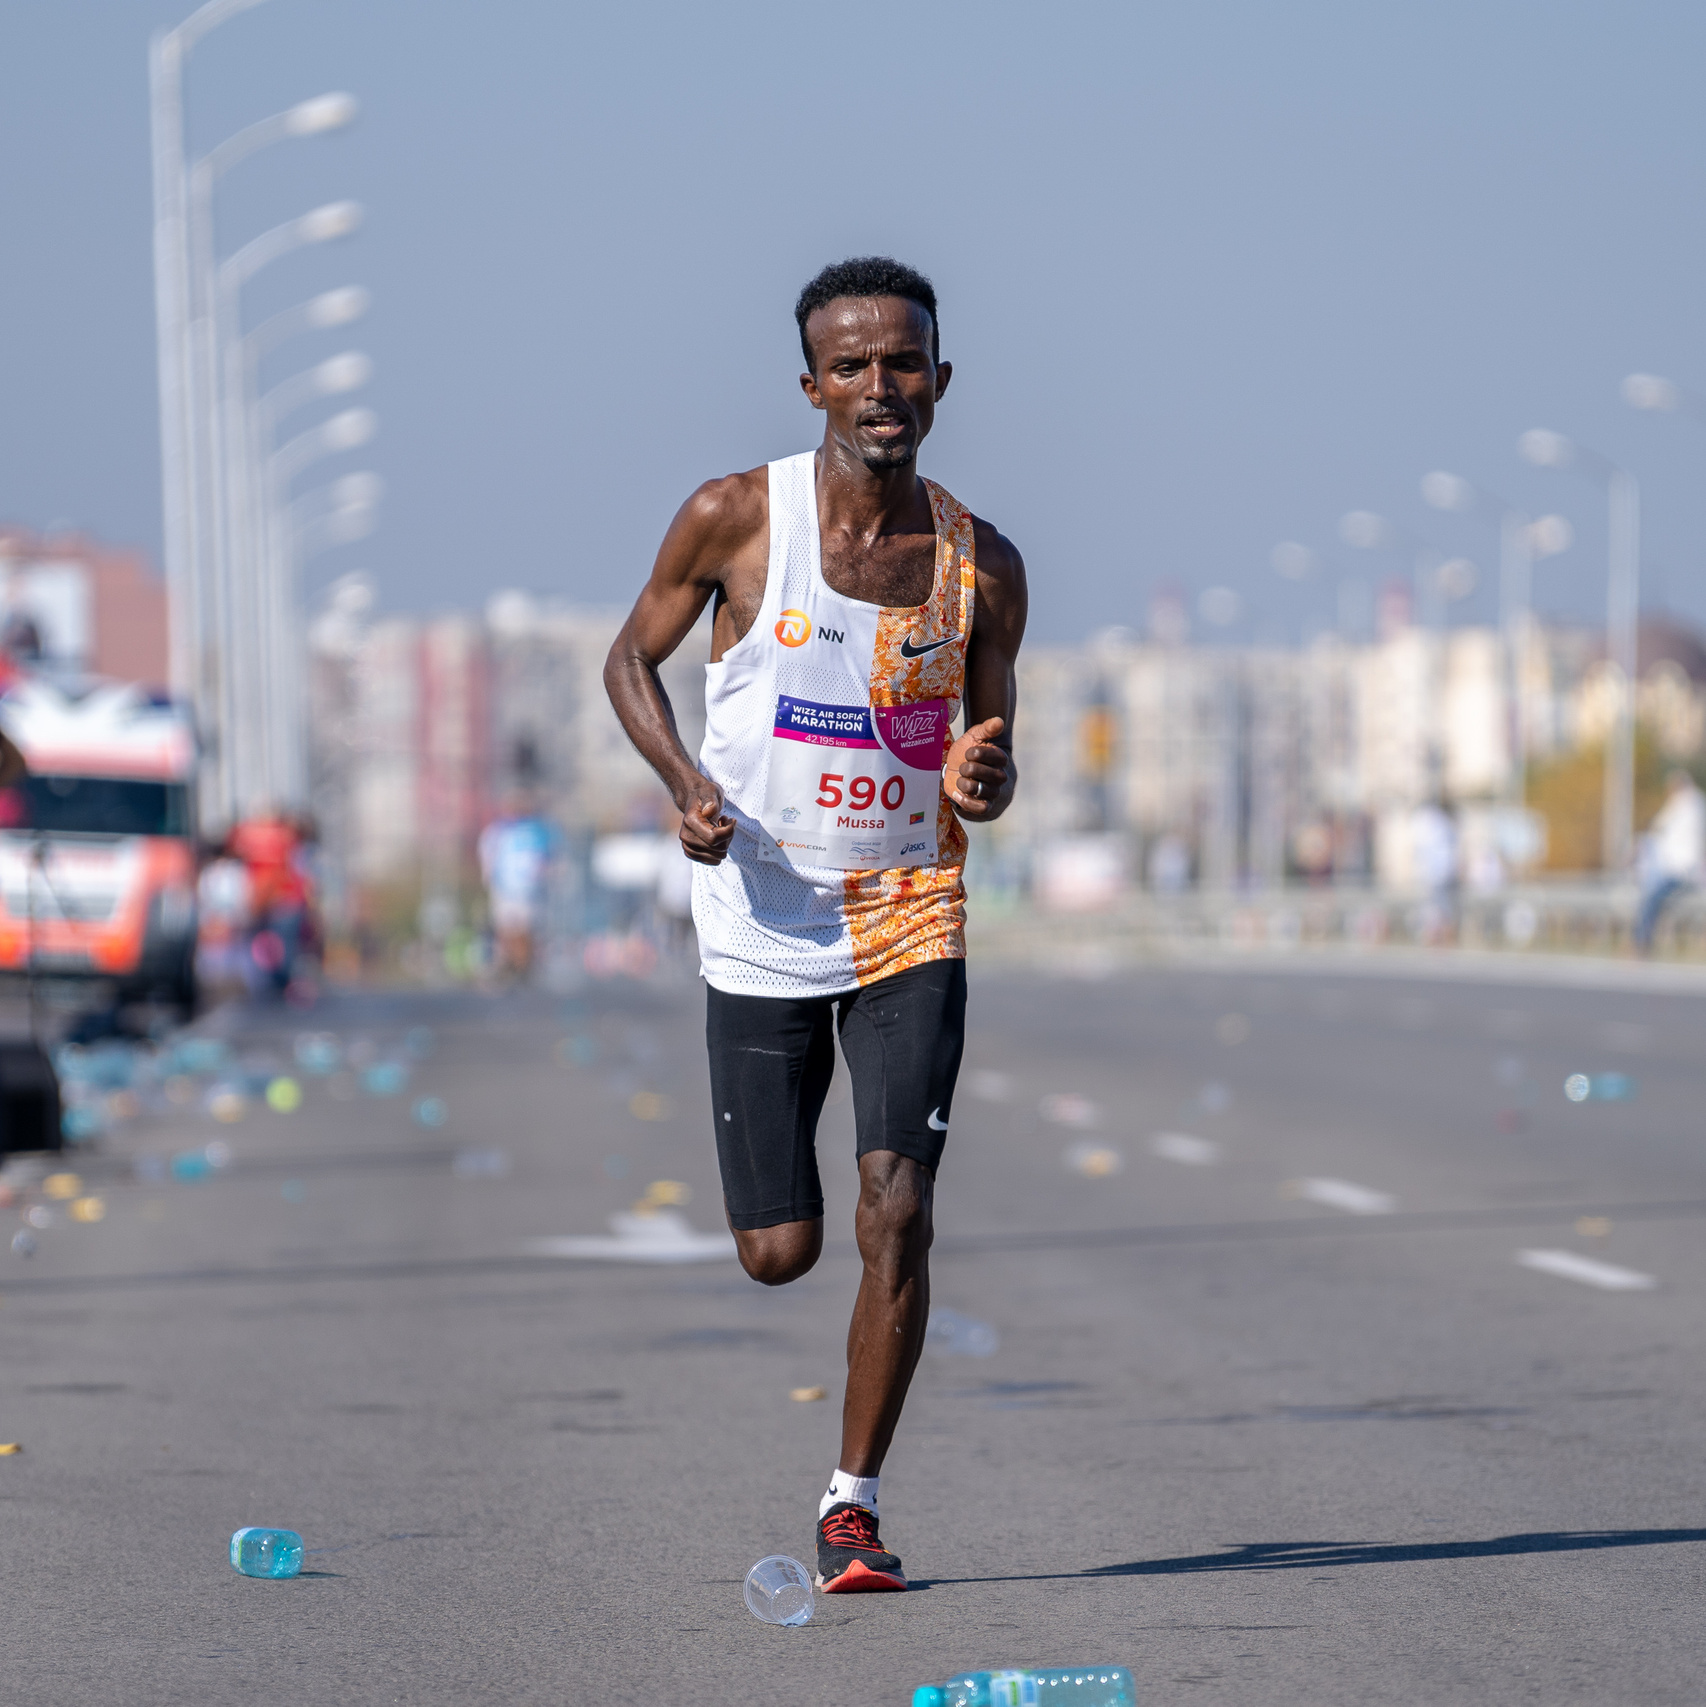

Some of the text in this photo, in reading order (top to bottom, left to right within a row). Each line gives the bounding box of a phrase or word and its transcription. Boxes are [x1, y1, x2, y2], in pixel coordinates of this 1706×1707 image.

[818, 626, 845, 644] NN
[793, 705, 863, 721] WIZZ AIR SOFIA
[791, 714, 863, 732] MARATHON
[805, 735, 835, 746] 42.195
[900, 736, 935, 748] wizzair.com
[815, 773, 906, 811] 590
[836, 815, 885, 829] Mussa
[786, 842, 827, 852] VIVACOM
